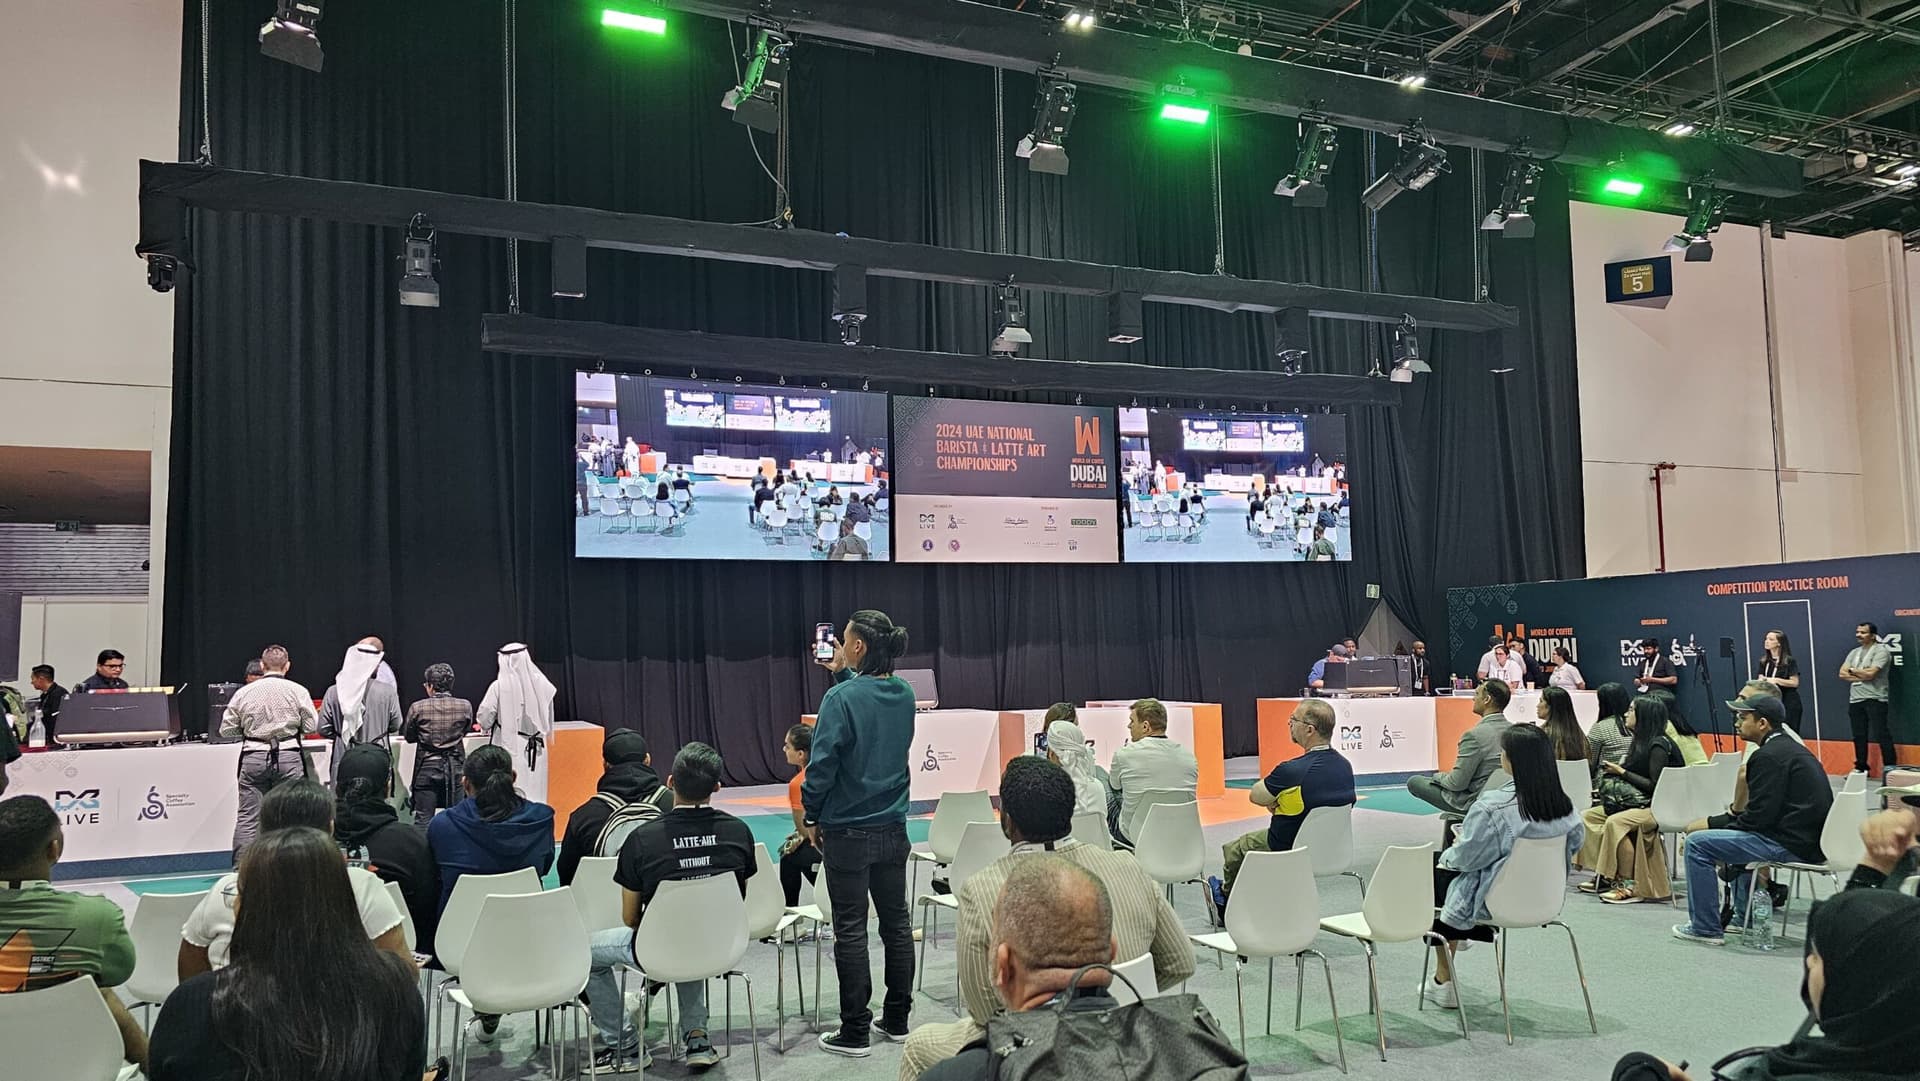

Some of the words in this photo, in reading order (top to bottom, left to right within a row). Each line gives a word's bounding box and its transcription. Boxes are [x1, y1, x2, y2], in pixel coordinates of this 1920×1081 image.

[1632, 276, 1643, 291] 5
[936, 424, 962, 438] 2024
[966, 425, 984, 439] UAE
[987, 426, 1035, 441] NATIONAL
[936, 440, 978, 455] BARISTA
[991, 443, 1024, 457] LATTE
[1027, 444, 1046, 457] ART
[936, 456, 1018, 472] CHAMPIONSHIPS
[1070, 464, 1107, 482] DUBAI
[1707, 582, 1767, 595] COMPETITION
[1769, 578, 1814, 592] PRACTICE
[1816, 576, 1849, 589] ROOM
[1341, 742, 1362, 750] LIVE
[66, 813, 99, 825] IVE
[673, 835, 717, 849] LATTE-ART
[679, 856, 712, 869] WITHOUT
